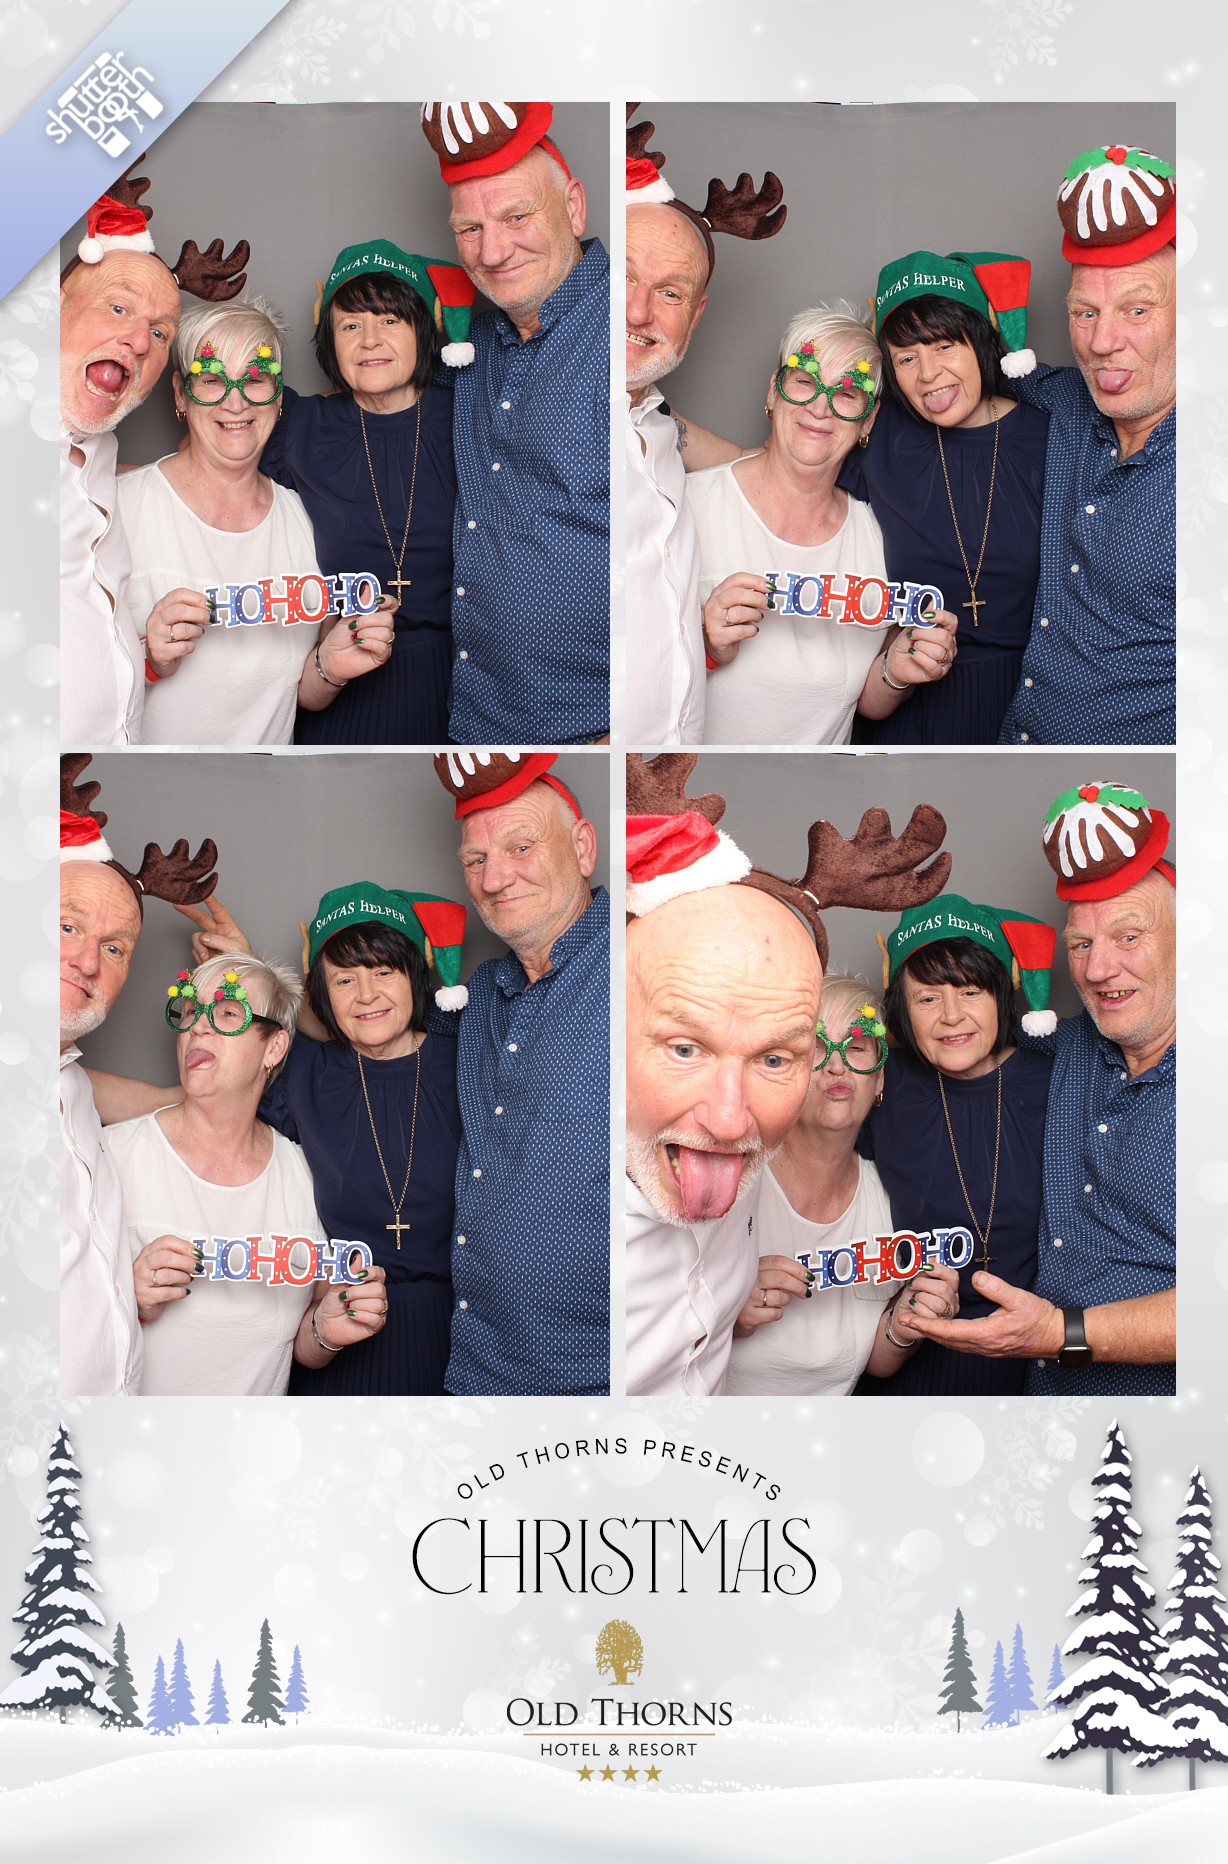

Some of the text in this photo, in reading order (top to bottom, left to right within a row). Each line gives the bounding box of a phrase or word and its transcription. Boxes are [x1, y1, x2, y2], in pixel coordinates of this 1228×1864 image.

[373, 253, 418, 281] HELPER
[913, 272, 966, 292] HELPER
[316, 900, 407, 933] SANTAS HELPER
[897, 913, 996, 947] SANTAS HELPER
